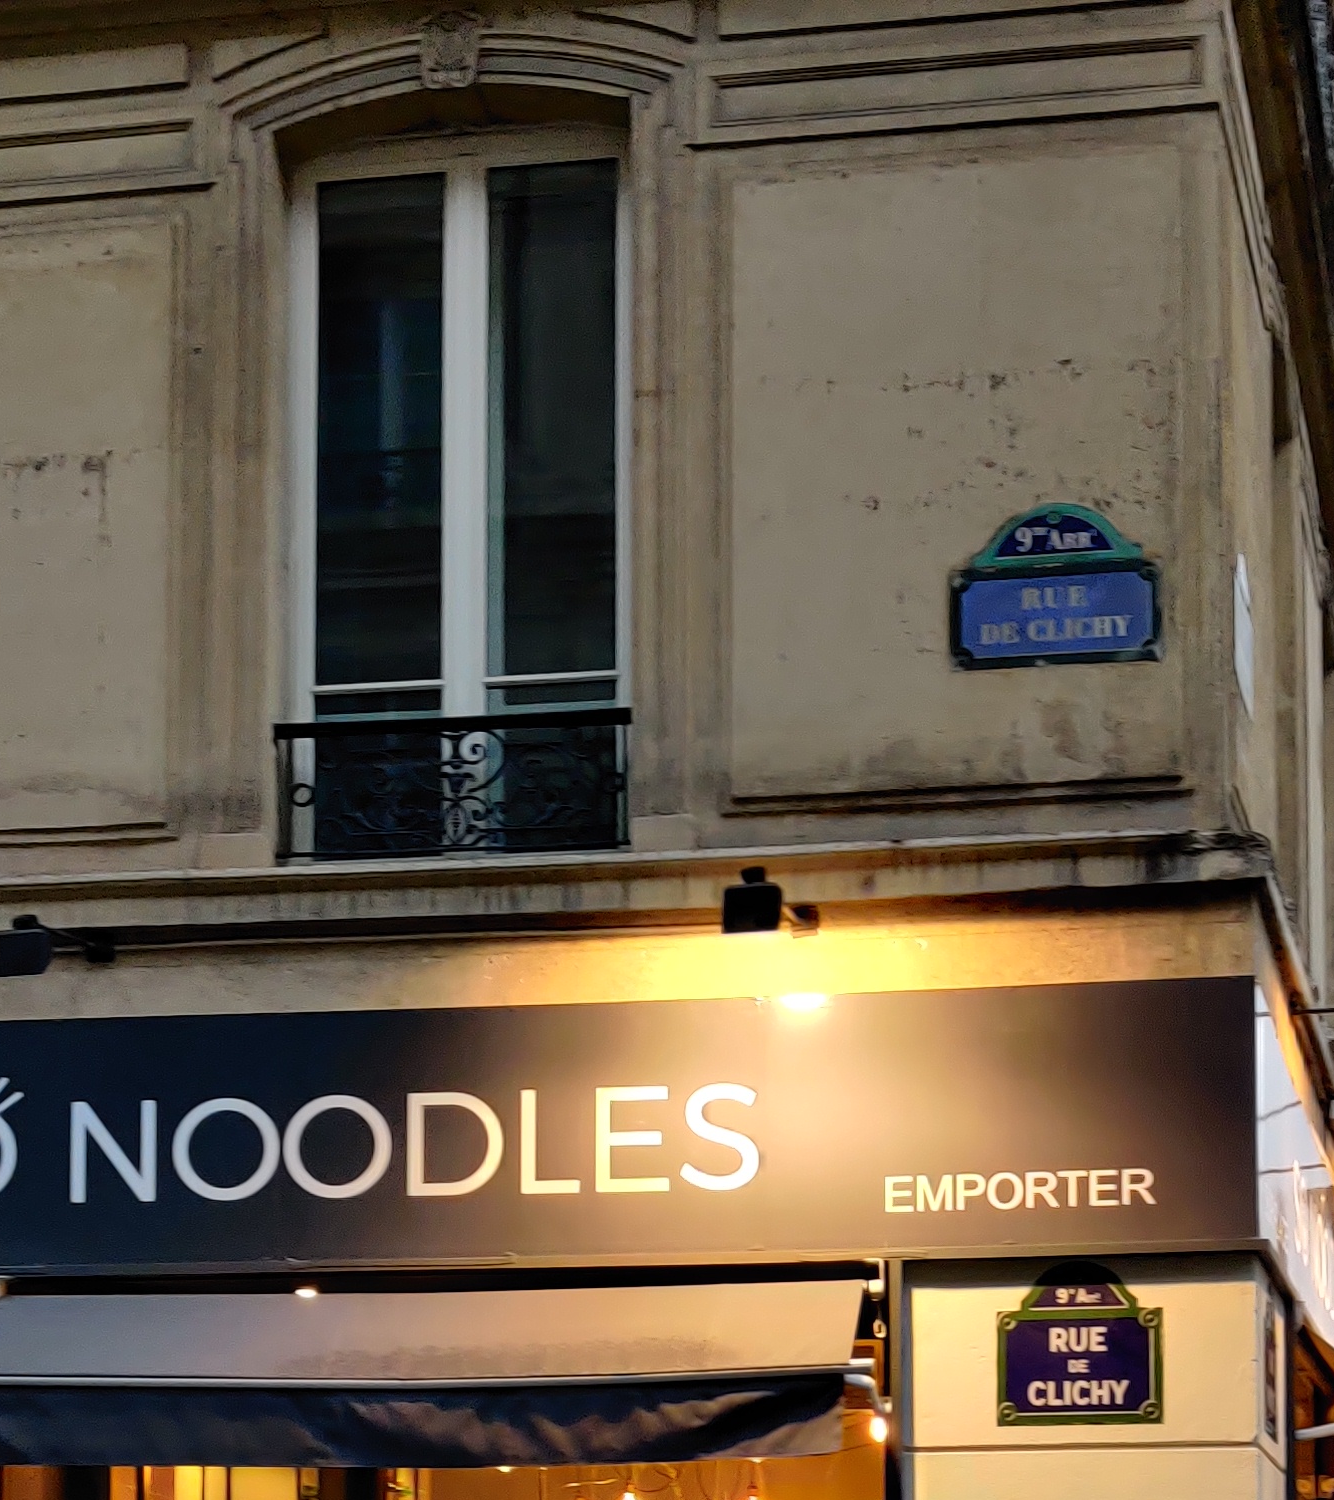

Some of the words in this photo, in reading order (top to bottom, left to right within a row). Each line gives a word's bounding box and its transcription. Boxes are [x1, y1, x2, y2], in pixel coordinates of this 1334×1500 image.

[1021, 585, 1087, 610] RUE
[980, 621, 1019, 645] DE
[1027, 615, 1133, 642] CLICHY
[69, 1082, 761, 1204] NOODLES
[884, 1168, 1157, 1213] EMPORTER
[1048, 1326, 1108, 1353] RUE
[1067, 1359, 1090, 1374] DE
[1027, 1380, 1130, 1406] CLICHY
